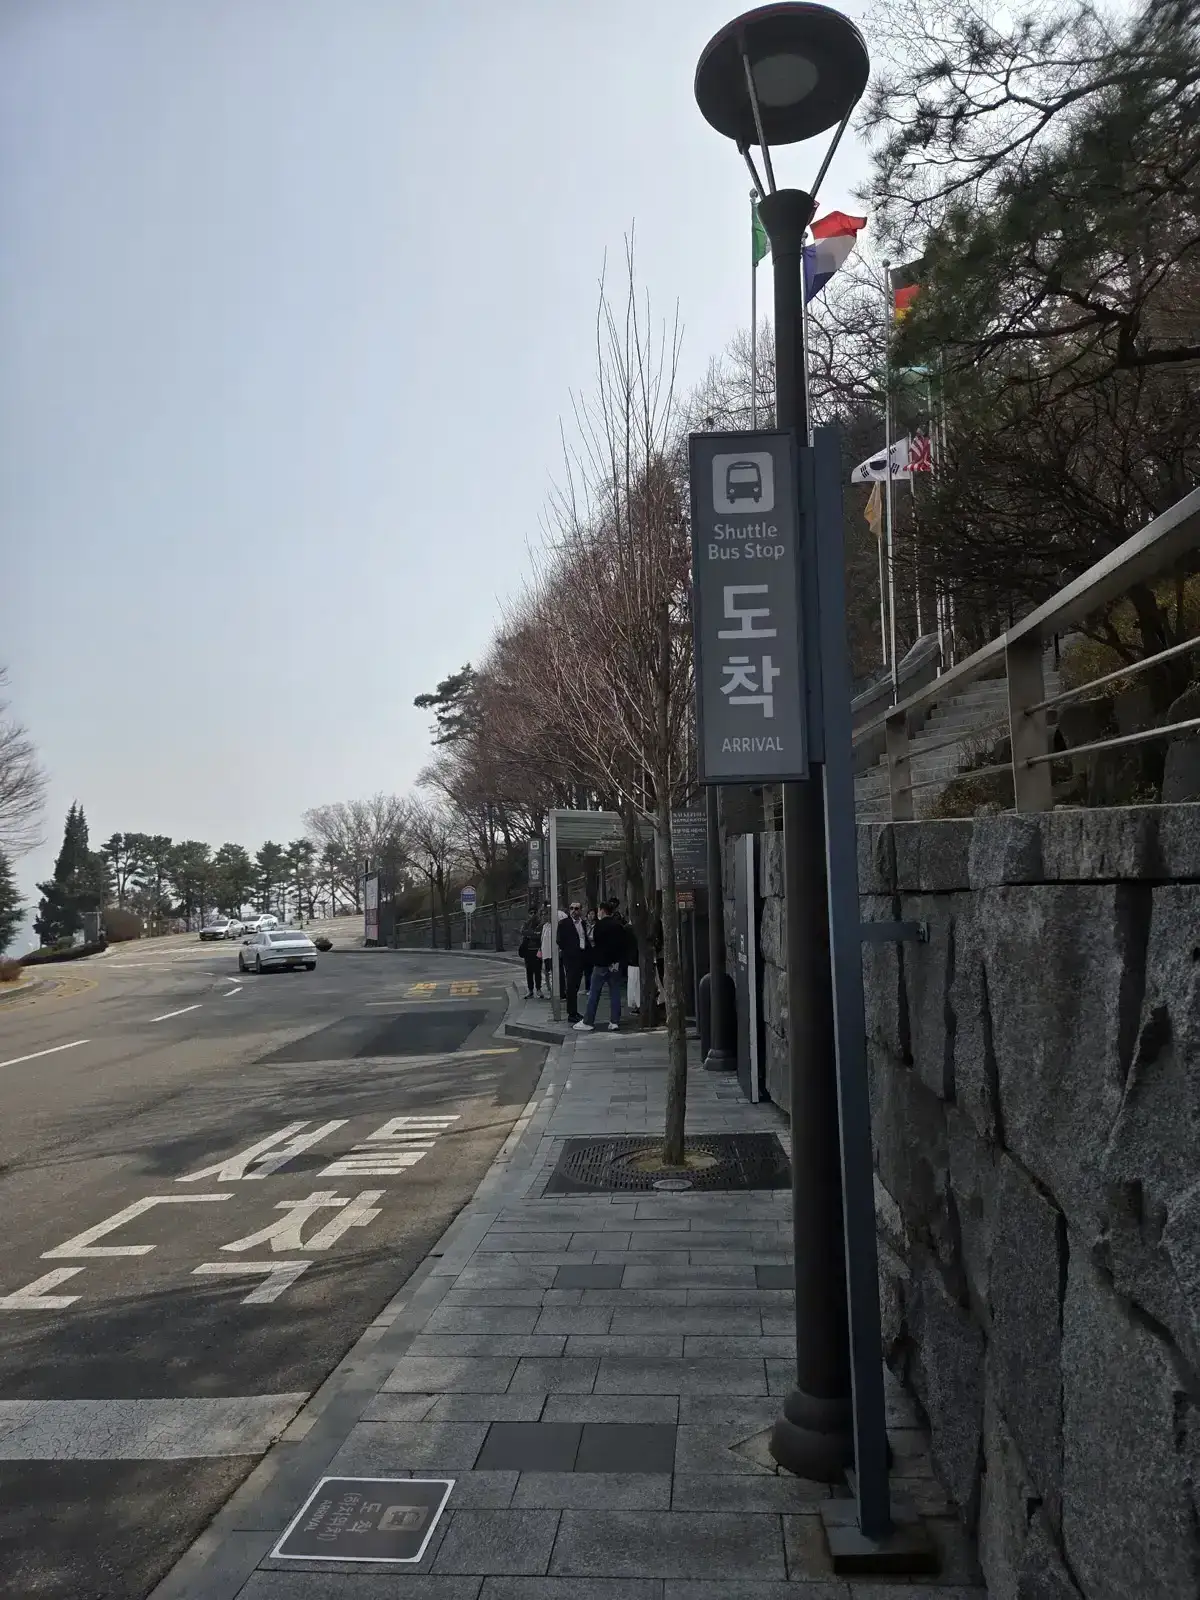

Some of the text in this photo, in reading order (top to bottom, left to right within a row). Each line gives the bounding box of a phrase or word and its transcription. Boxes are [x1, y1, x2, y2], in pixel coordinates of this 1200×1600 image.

[713, 521, 778, 540] Shuttle
[708, 542, 785, 561] Bus Stop
[717, 583, 781, 719] 도착
[721, 736, 784, 753] ARRIVAL
[174, 1115, 462, 1182] 셔틀
[303, 1499, 333, 1532] ARRIVAL
